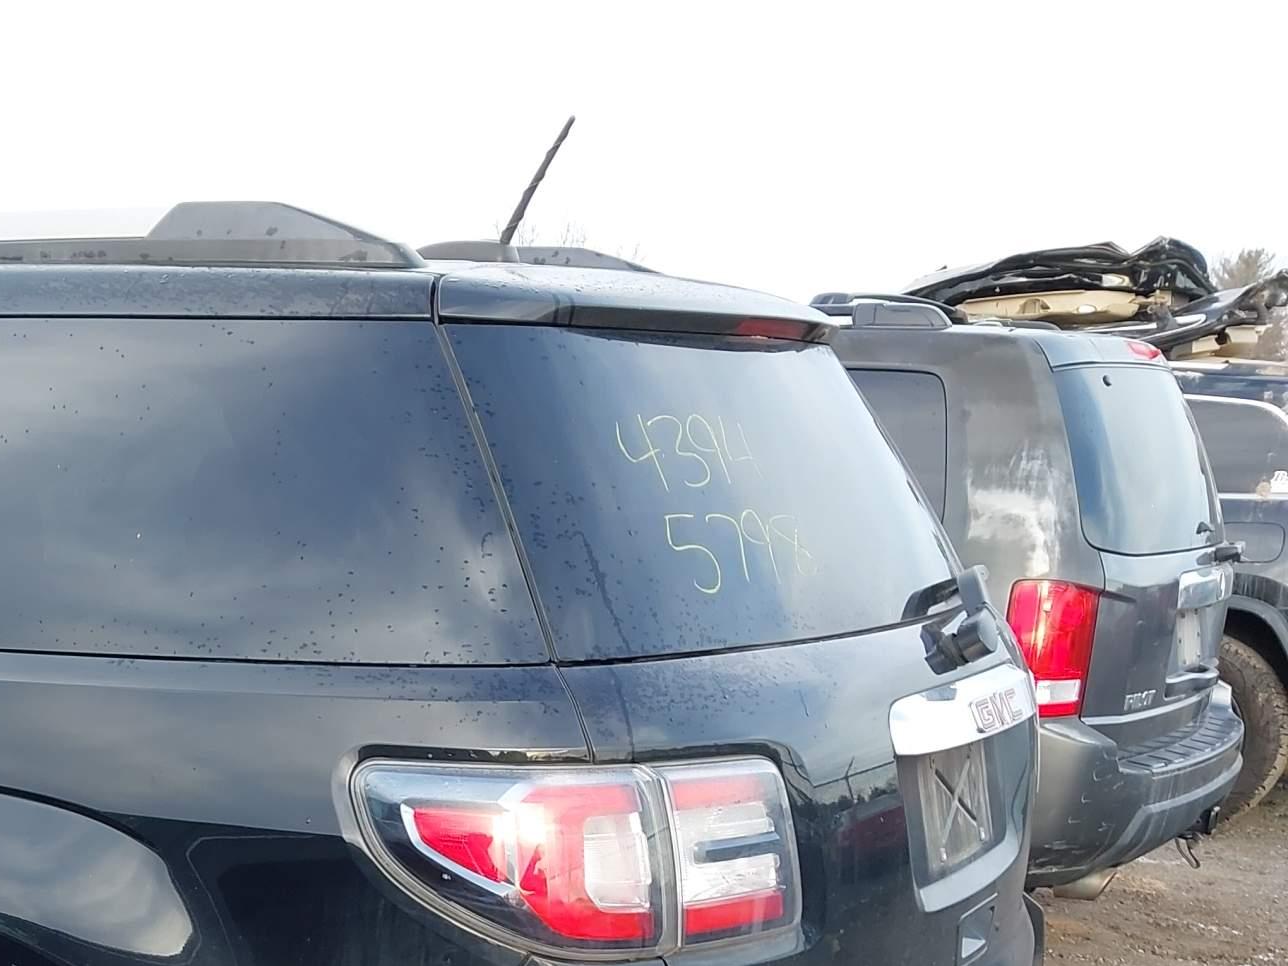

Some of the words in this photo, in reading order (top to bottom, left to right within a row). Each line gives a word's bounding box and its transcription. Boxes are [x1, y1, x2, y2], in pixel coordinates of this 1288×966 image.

[614, 413, 765, 492] 4394
[664, 508, 817, 595] 5798
[969, 688, 1024, 733] GMC
